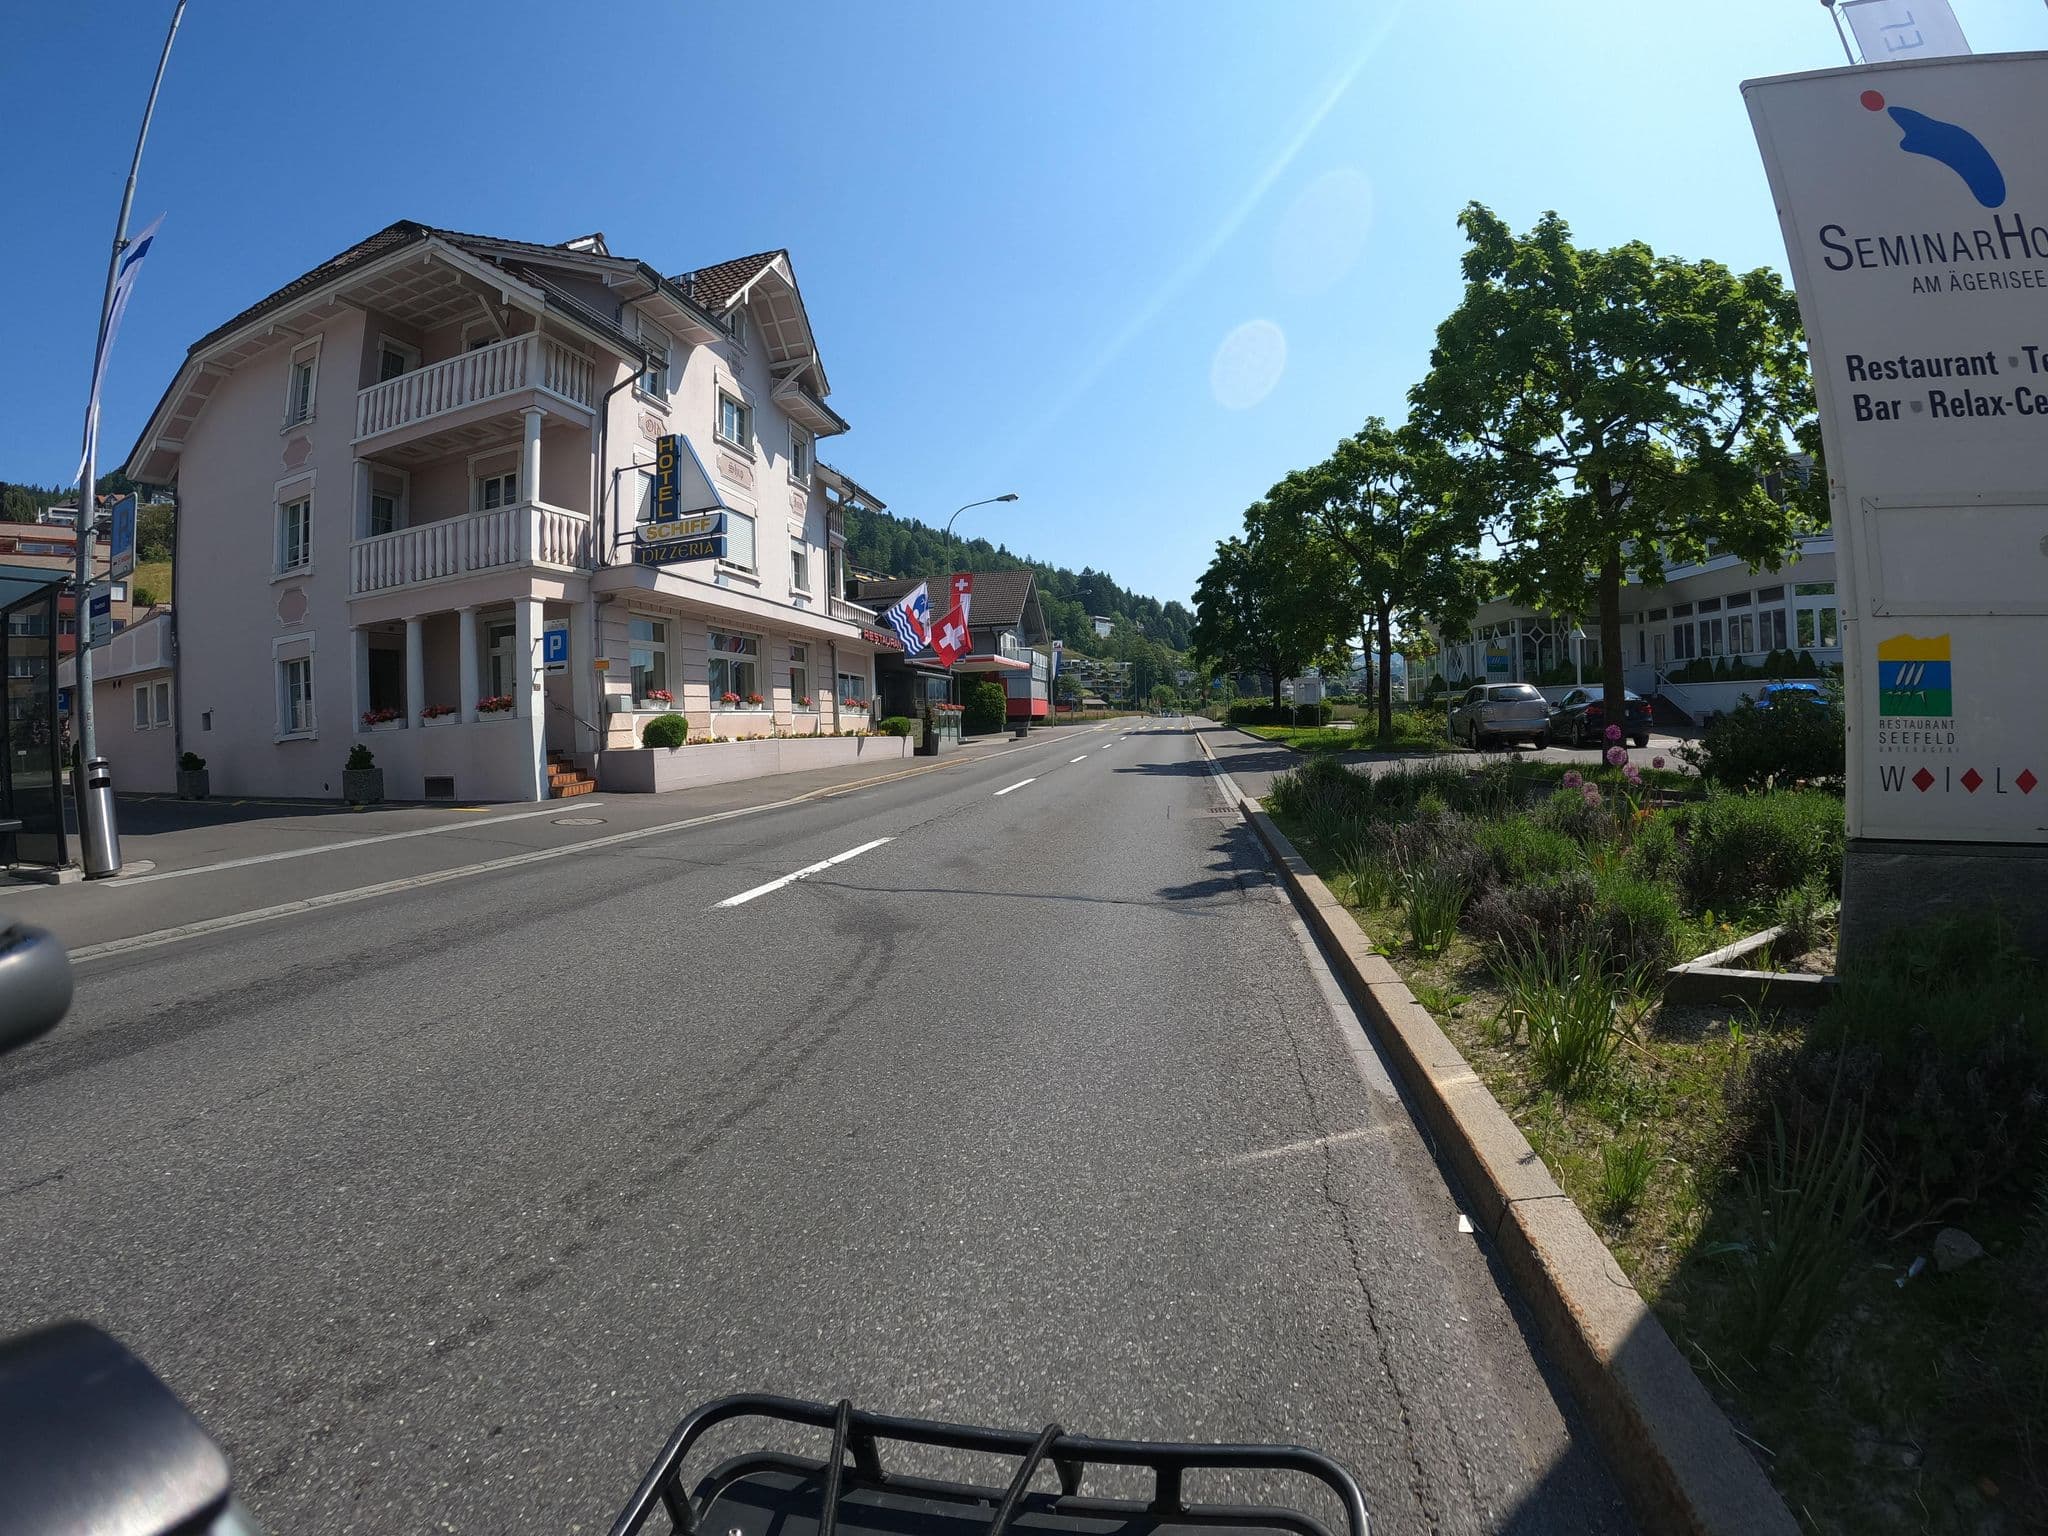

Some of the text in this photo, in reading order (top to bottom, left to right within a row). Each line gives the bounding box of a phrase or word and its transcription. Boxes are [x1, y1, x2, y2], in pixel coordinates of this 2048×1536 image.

[1912, 269, 2047, 294] AM ÄGERISEE
[1846, 351, 1999, 382] Restaurant
[1853, 394, 1901, 422] Bar
[658, 436, 674, 518] HOTEL
[646, 517, 711, 540] SCHIFF
[549, 635, 562, 659] P
[1879, 719, 1956, 730] RESTAURANT
[1879, 731, 1955, 745] SEEFELD
